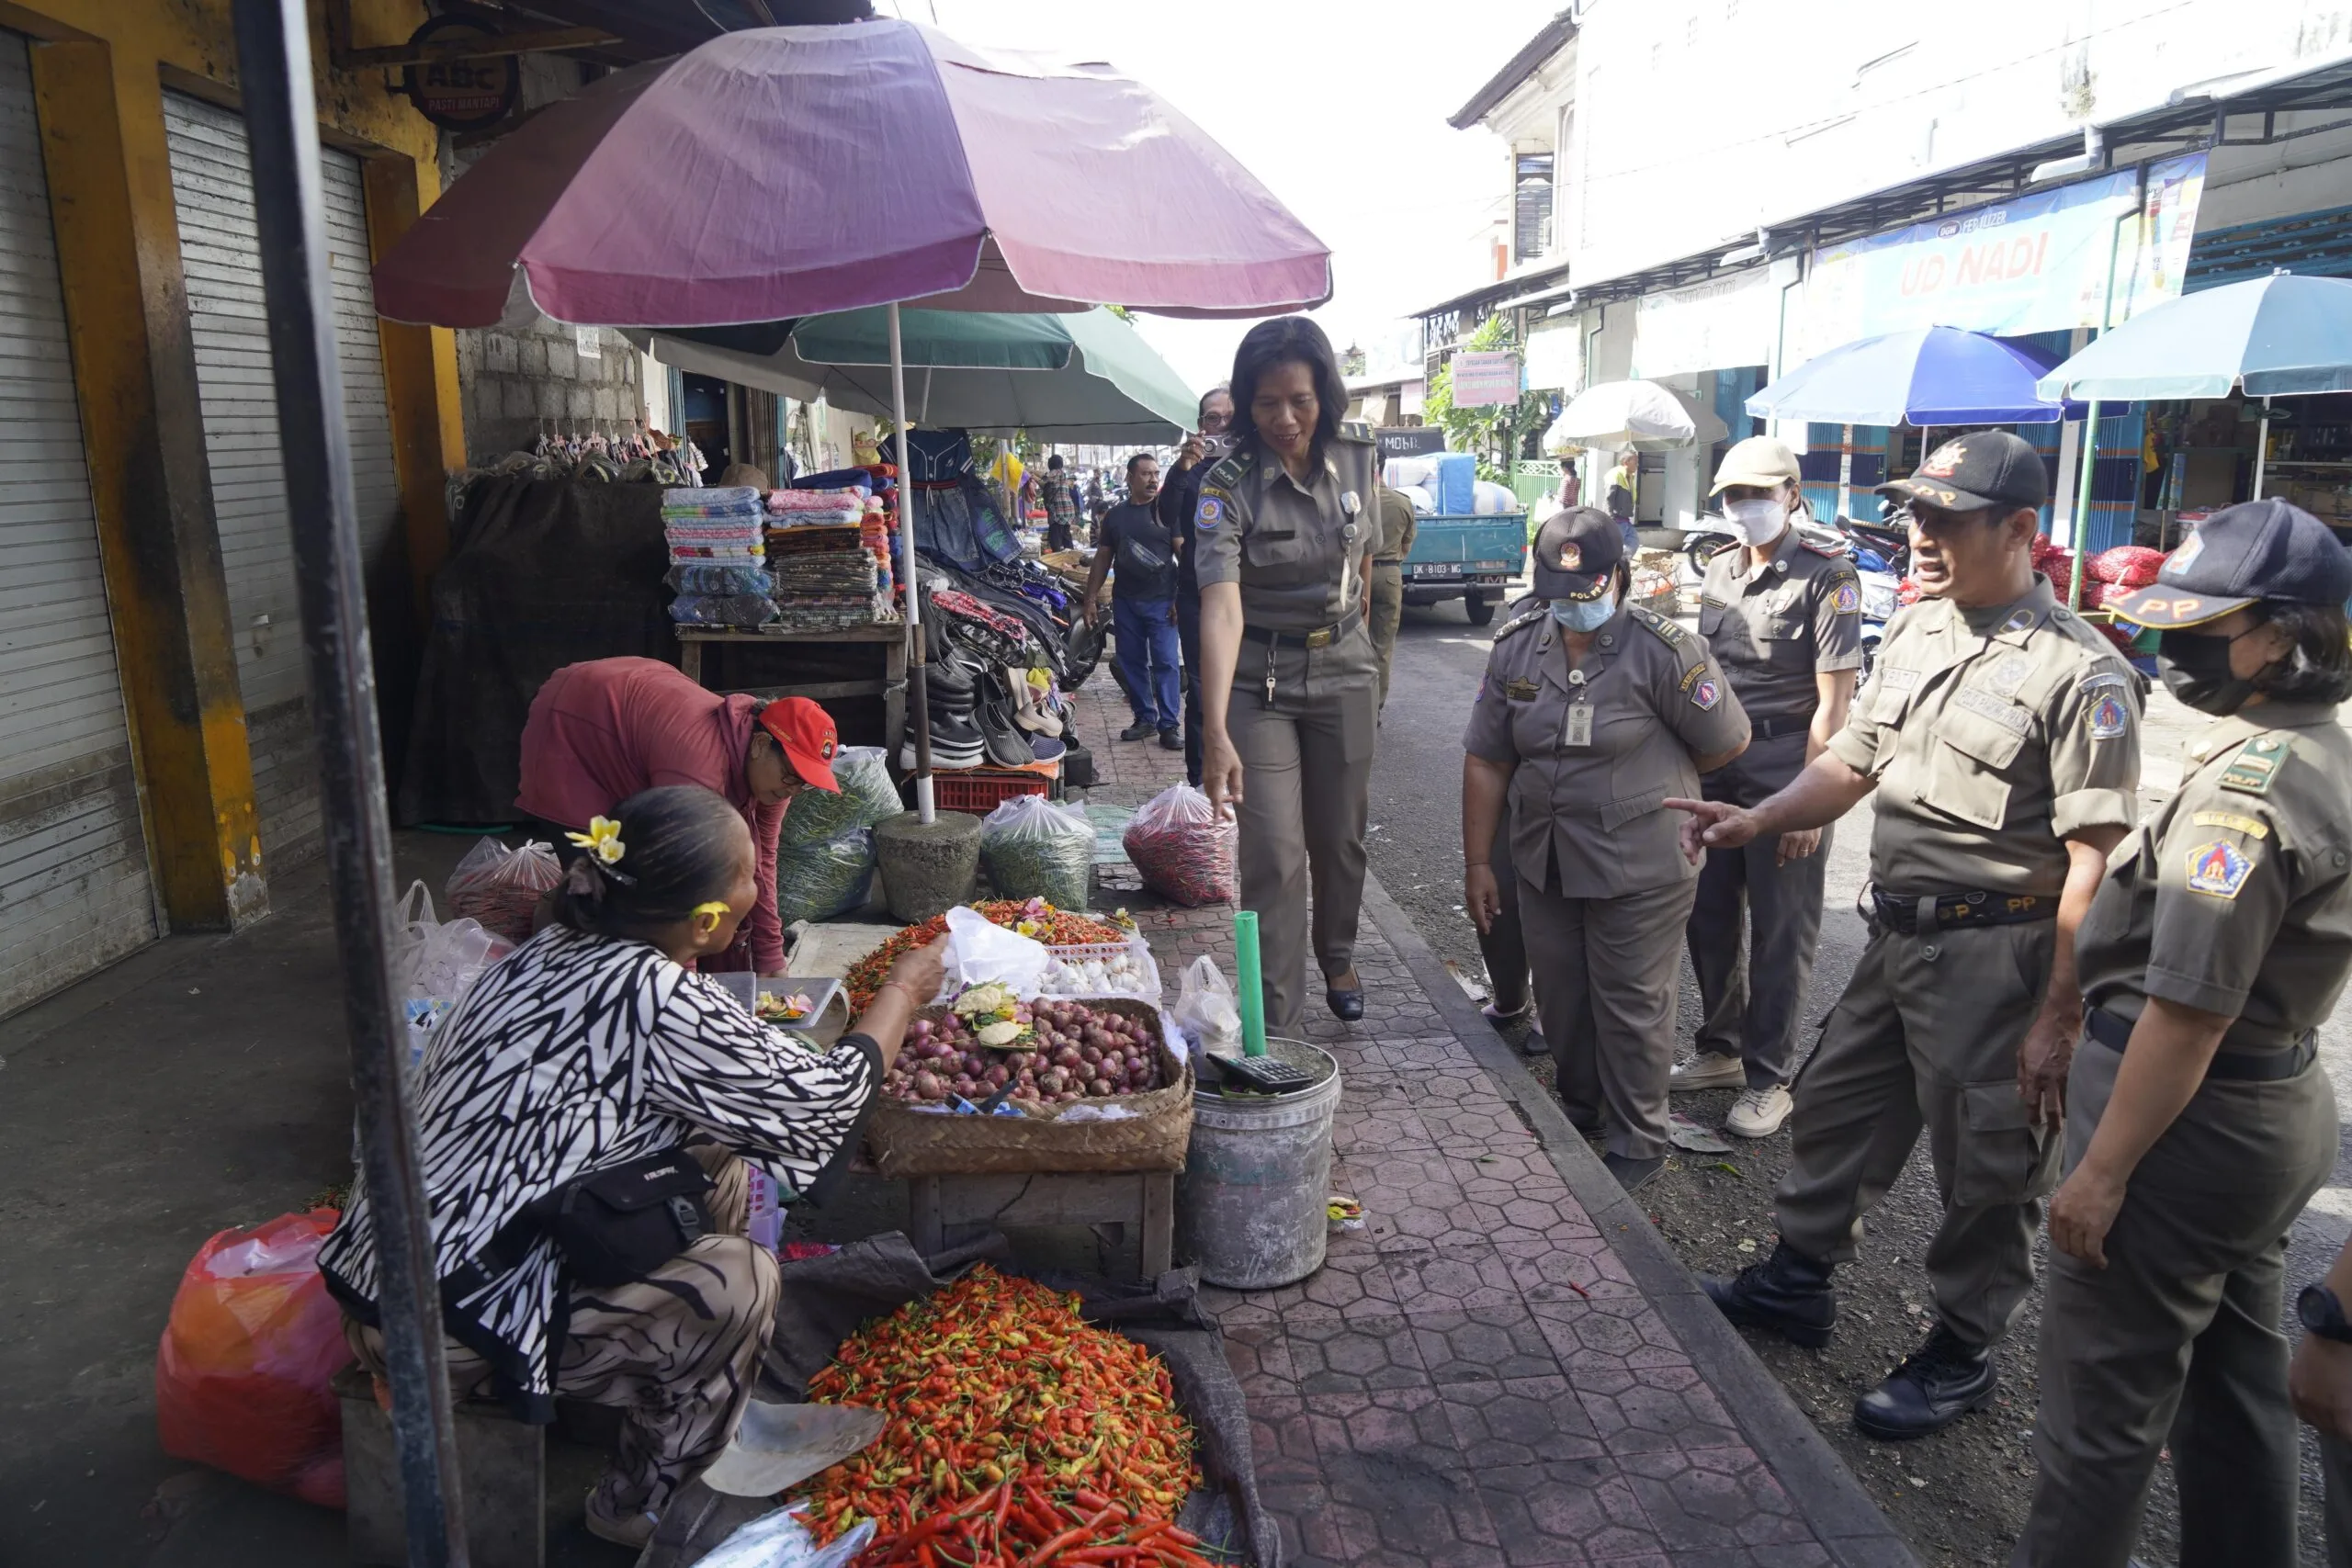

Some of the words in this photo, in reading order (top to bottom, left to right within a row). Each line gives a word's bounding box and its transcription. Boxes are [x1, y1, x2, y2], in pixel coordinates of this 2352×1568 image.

[425, 60, 495, 90] ABC
[428, 97, 456, 112] PASTI
[1939, 224, 1958, 236] DGW
[1901, 254, 1946, 297] UD
[1955, 231, 2049, 286] NADI
[1413, 564, 1423, 574] DK
[1428, 564, 1446, 574] 8103
[1451, 564, 1462, 574] MG
[1590, 585, 1601, 597] PP
[2007, 896, 2037, 913] PP
